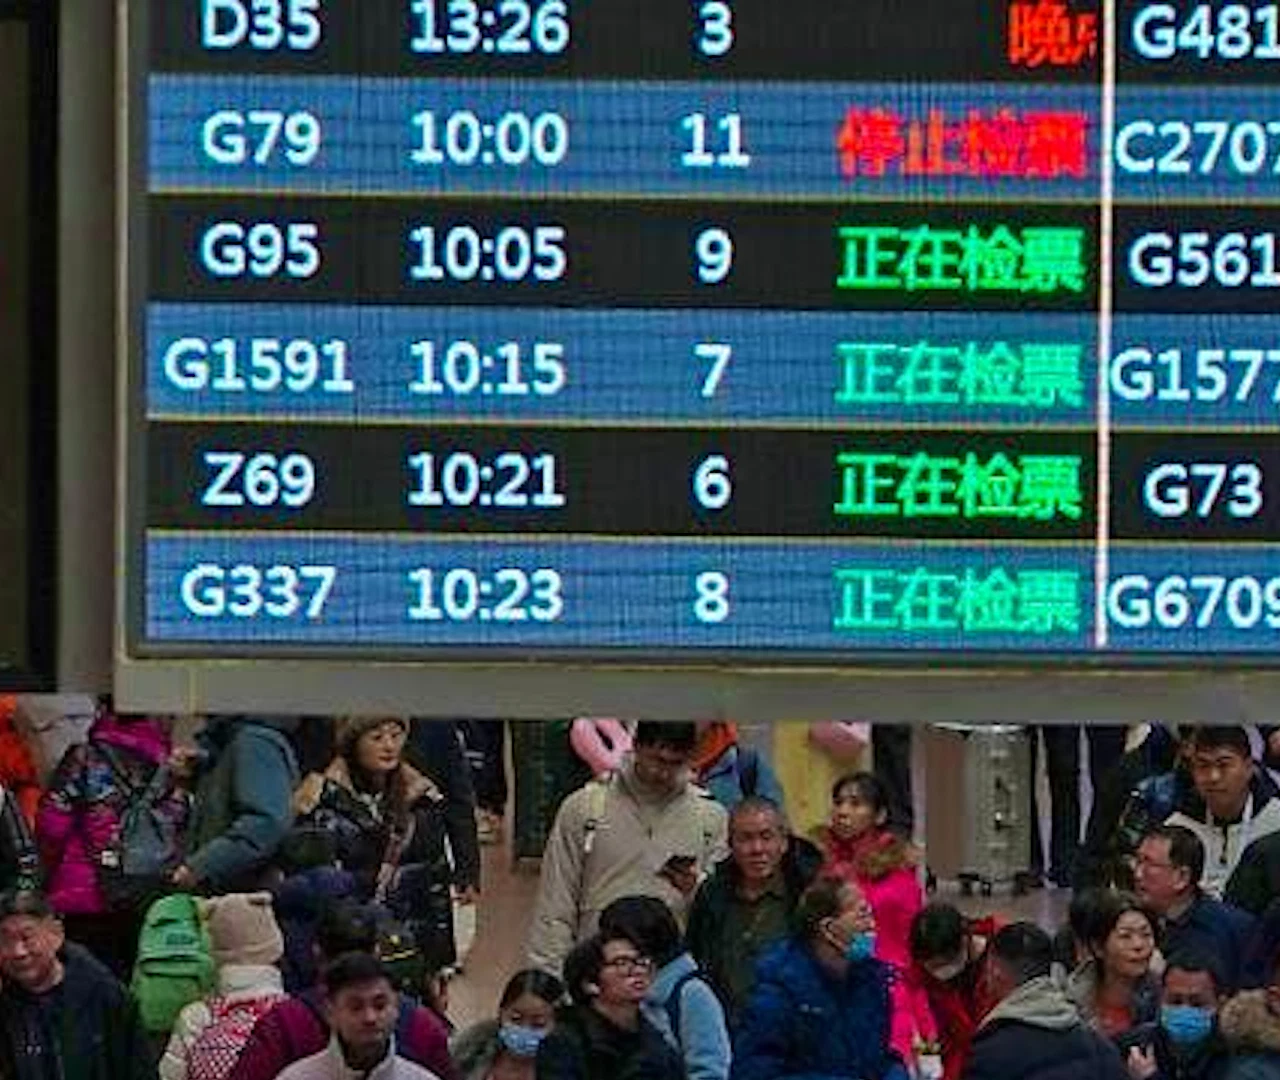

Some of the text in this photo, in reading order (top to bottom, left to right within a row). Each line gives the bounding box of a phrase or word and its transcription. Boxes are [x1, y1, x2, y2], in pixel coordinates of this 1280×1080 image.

[201, 0, 320, 50] D35
[412, 0, 569, 53] 13:26
[701, 1, 732, 55] 3
[201, 112, 321, 166] G79
[410, 110, 568, 165] 10:00
[681, 113, 751, 168] 11
[202, 223, 1085, 292] G95 10:05 9 正在检票
[164, 338, 1085, 408] G1591 10:15 7 正在检票
[203, 452, 1082, 519] Z69 10:21 6 正在检票
[1145, 464, 1262, 517] G73
[180, 565, 1082, 636] G337 10:23 8 正在检票
